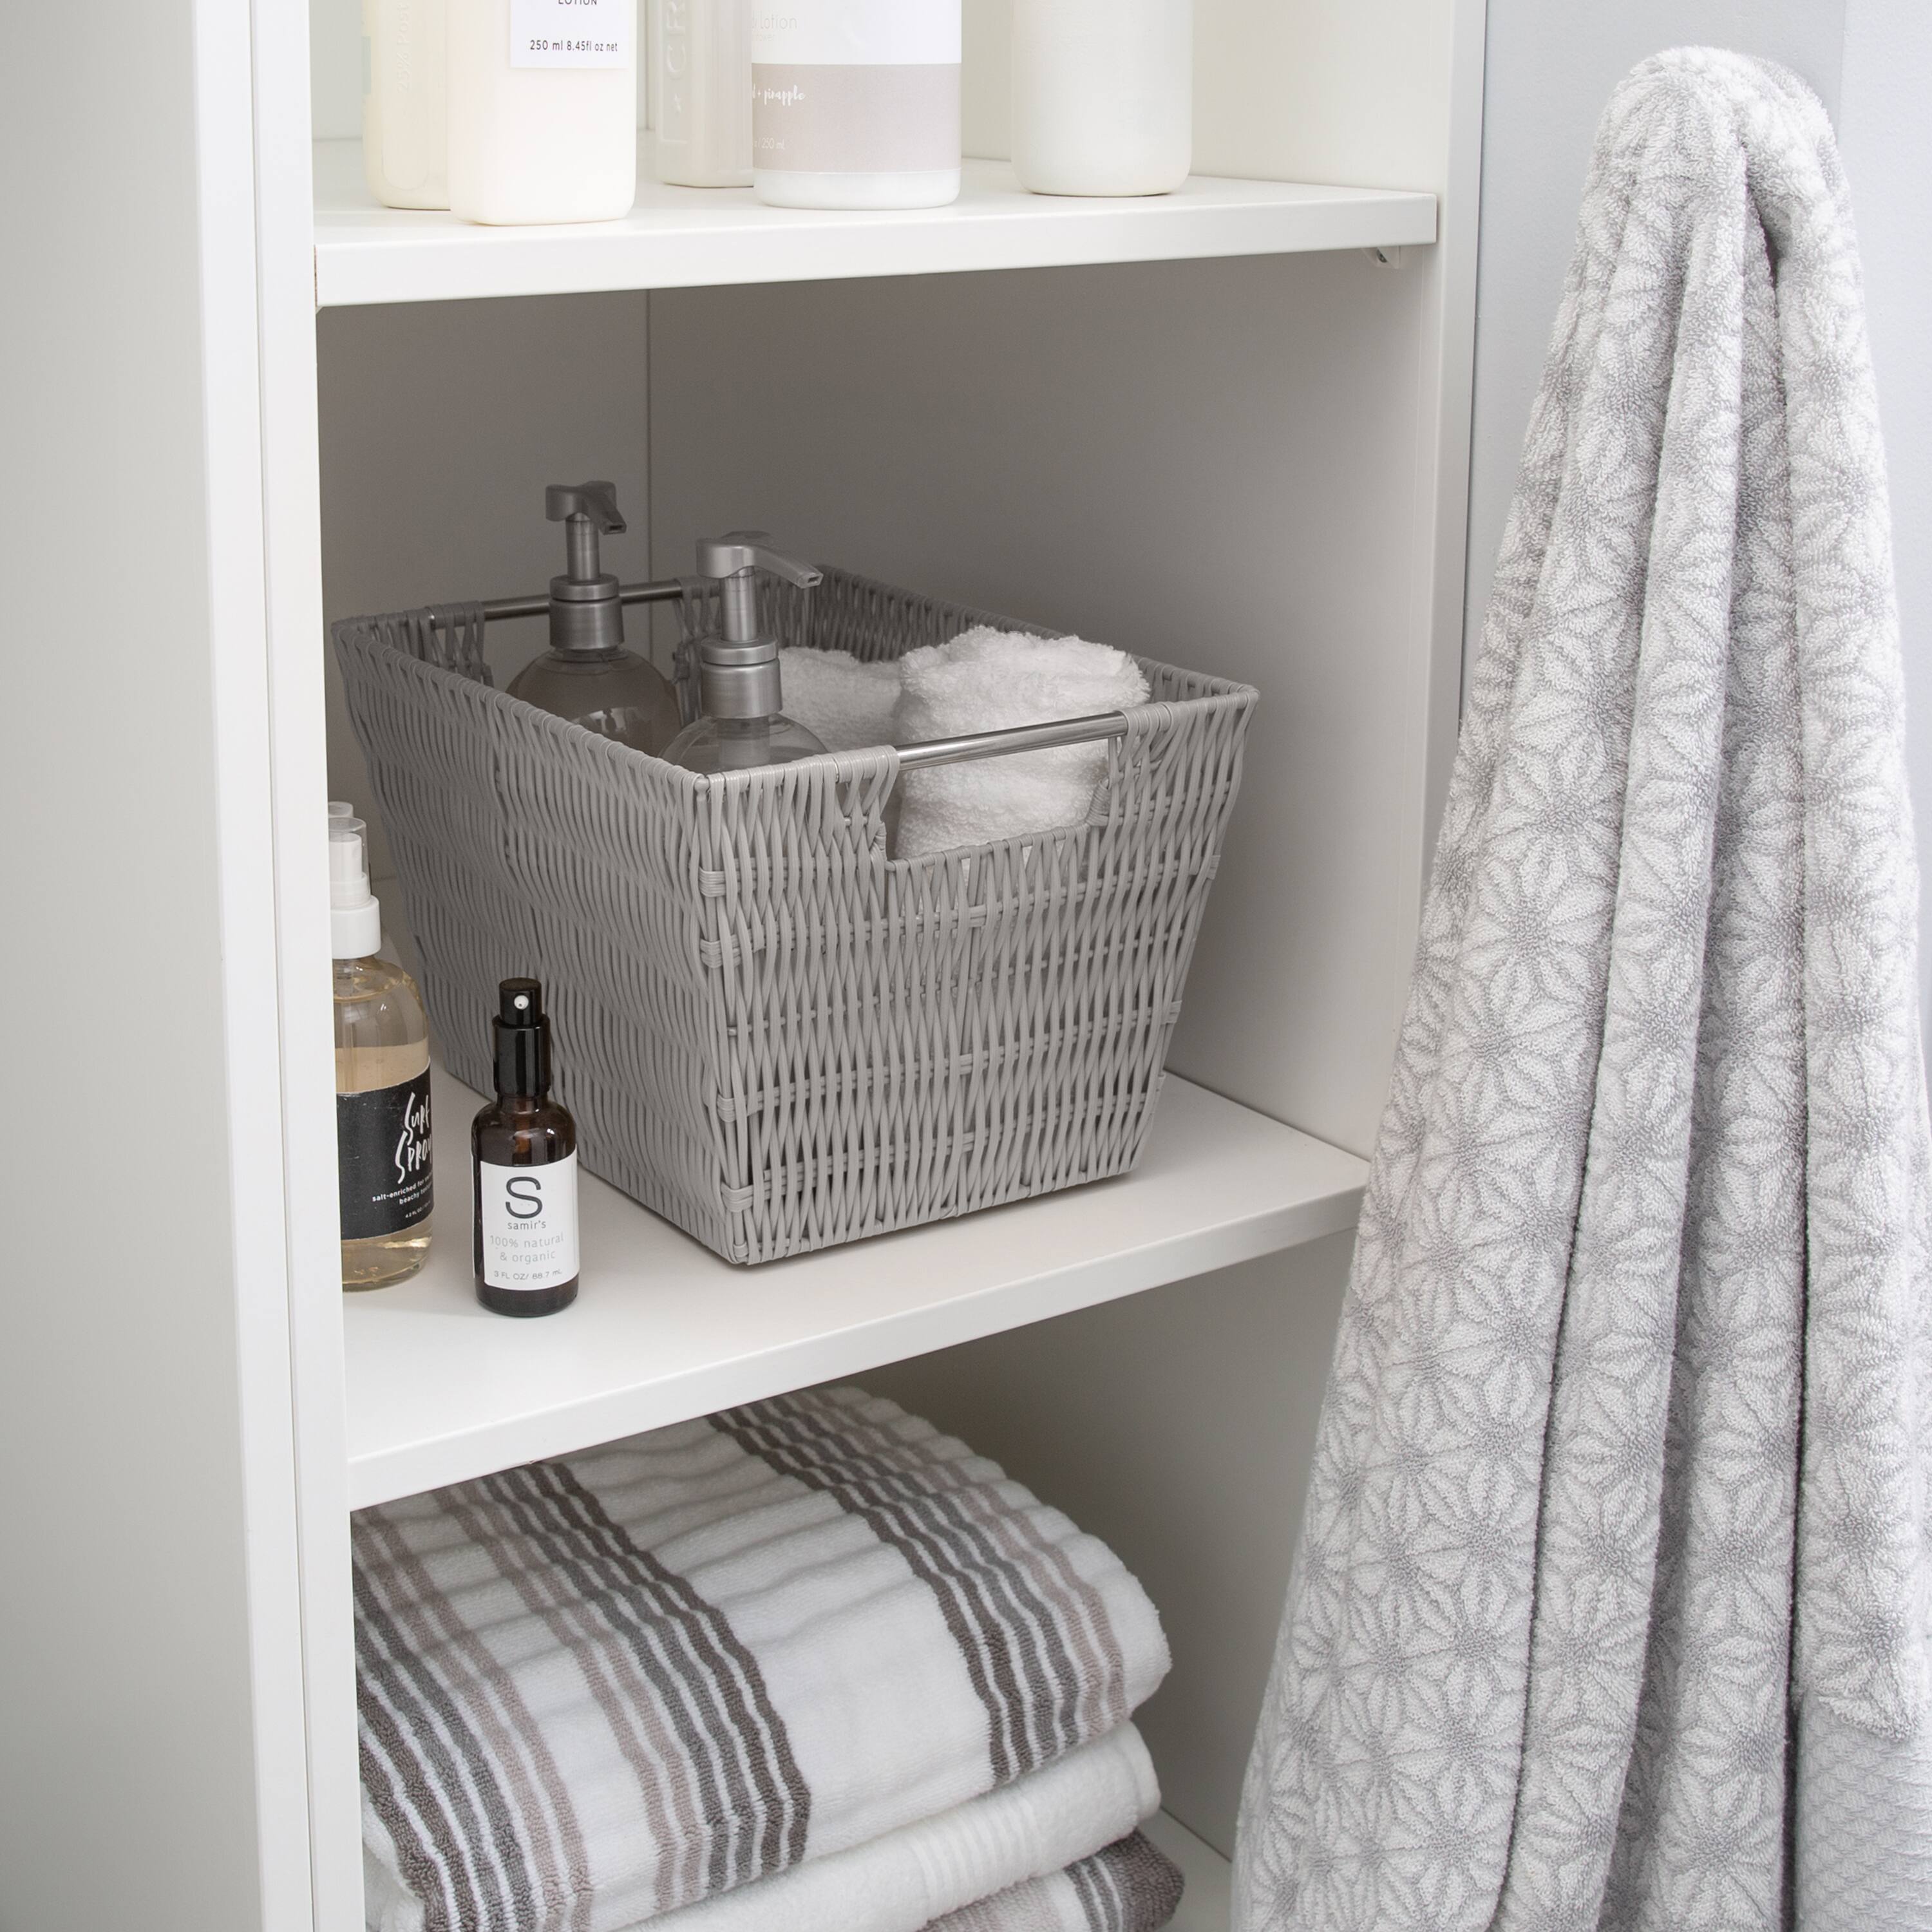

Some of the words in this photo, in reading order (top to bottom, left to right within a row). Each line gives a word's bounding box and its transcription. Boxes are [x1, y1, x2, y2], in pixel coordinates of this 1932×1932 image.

[530, 40, 548, 50] 250
[552, 40, 563, 51] ml
[567, 41, 592, 52] 8.45fl
[606, 43, 618, 52] net
[372, 1183, 417, 1202] salt-enriched
[399, 1191, 420, 1205] beachy
[506, 1176, 543, 1219] S
[507, 1220, 546, 1230] samir's
[489, 1235, 518, 1248] 100%
[524, 1232, 564, 1248] natural
[499, 1251, 507, 1262] &
[512, 1250, 556, 1265] organic
